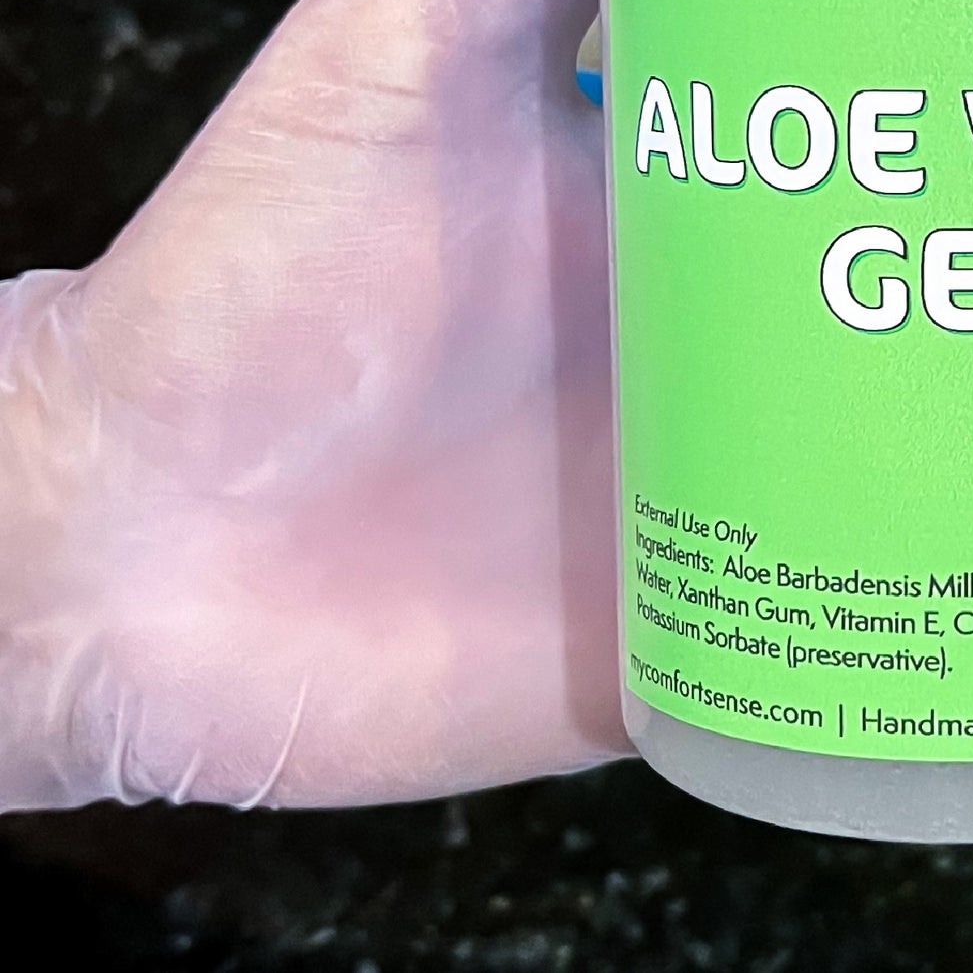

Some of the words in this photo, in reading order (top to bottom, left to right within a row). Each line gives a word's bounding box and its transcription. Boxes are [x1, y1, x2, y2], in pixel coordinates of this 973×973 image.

[634, 75, 928, 197] ALOE
[635, 493, 679, 529] External
[682, 511, 710, 538] Use
[714, 520, 758, 552] Only
[635, 524, 714, 575] Ingredients:
[722, 554, 772, 585] Aloe
[776, 563, 922, 599] Barbadensis
[635, 557, 673, 599] Water,
[677, 576, 750, 617] Xanthan
[754, 596, 817, 631] Gum,
[821, 604, 916, 634] Vitamin
[923, 610, 946, 638] E,
[636, 592, 701, 641] Potassium
[703, 621, 781, 660] Sorbate
[786, 635, 953, 680] (preservative).
[630, 651, 823, 728] mycomfortsense.com
